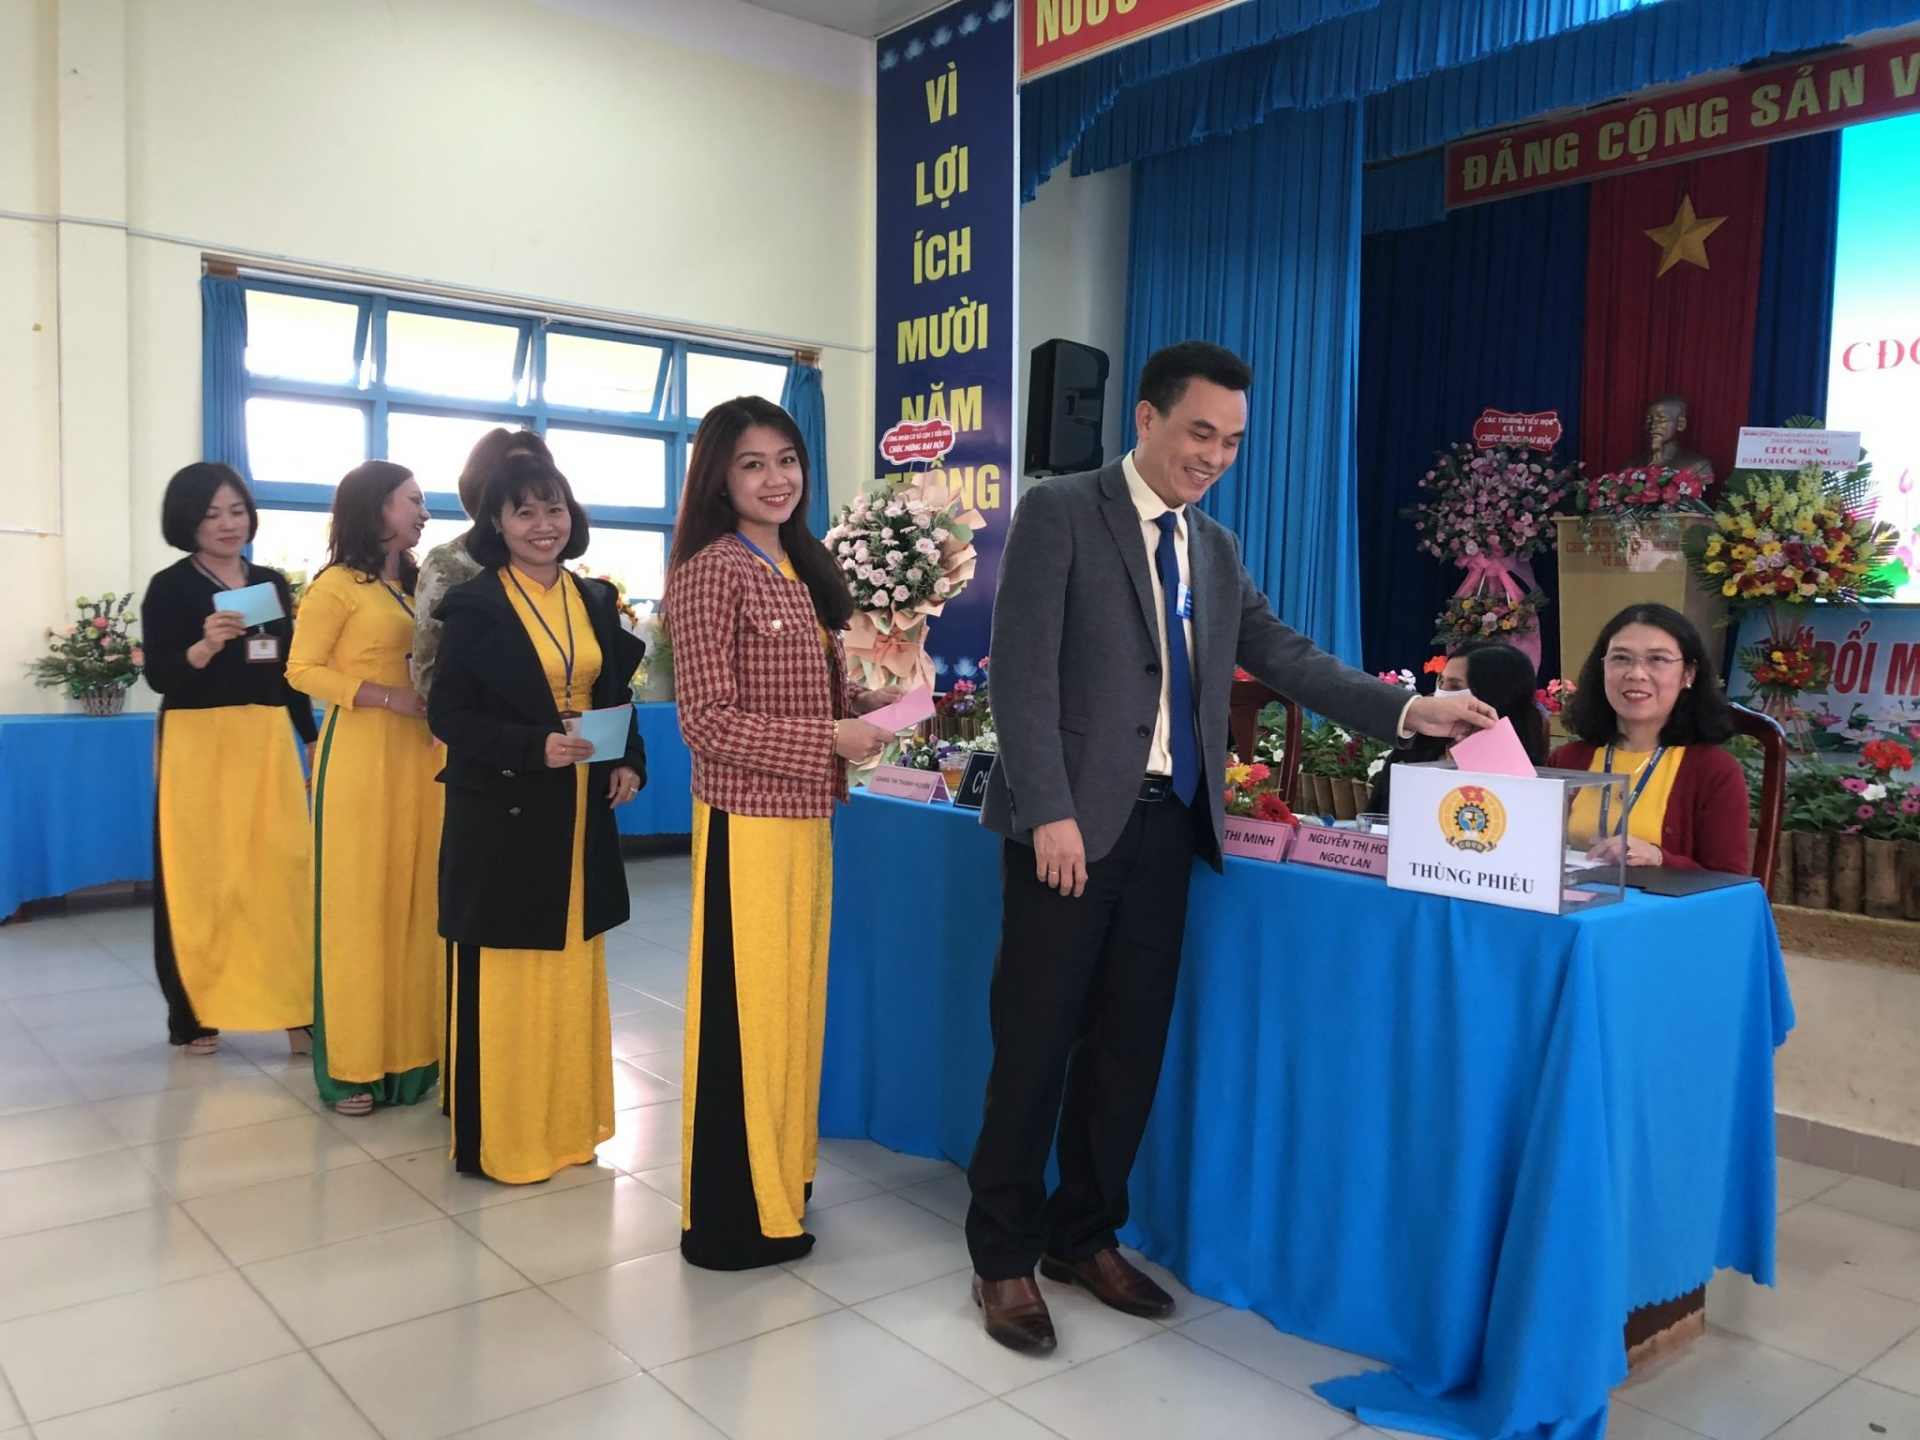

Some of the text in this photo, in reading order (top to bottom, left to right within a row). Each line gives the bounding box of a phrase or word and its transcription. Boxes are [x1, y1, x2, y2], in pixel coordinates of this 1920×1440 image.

[925, 61, 958, 124] VÌ
[1462, 138, 1580, 191] ĐẢNG
[1598, 97, 1729, 162] CỘNG
[1750, 64, 1865, 127] SẢN
[916, 145, 968, 208] LỢI
[913, 226, 971, 285] ÍCH
[898, 296, 988, 364] MƯỜI
[901, 381, 982, 433] NĂM
[1243, 832, 1275, 847] MINH
[1308, 832, 1388, 856] NGUYỄN THỊ HO
[1319, 851, 1372, 869] NGỌC LAN
[1408, 861, 1471, 885] THÙNG
